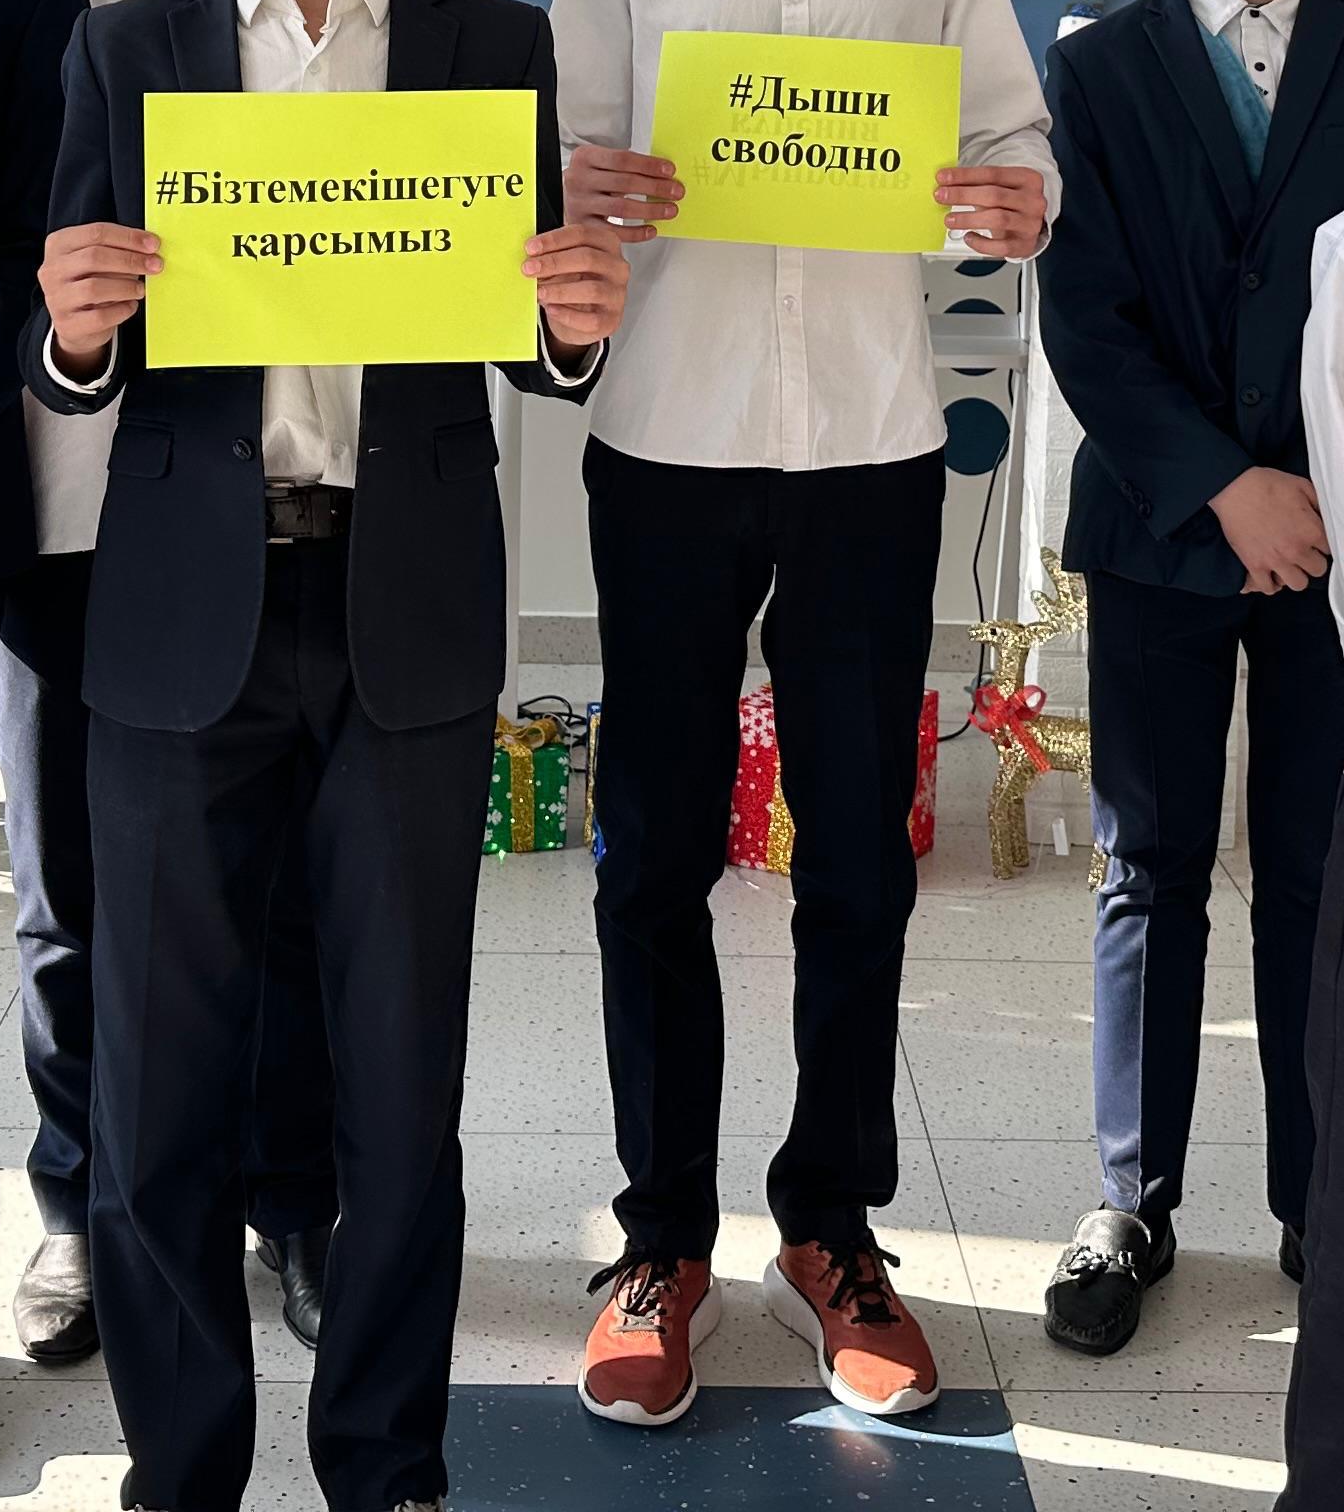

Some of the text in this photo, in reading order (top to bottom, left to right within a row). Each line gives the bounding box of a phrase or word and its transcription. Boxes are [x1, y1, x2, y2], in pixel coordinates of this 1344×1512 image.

[729, 73, 890, 119] #Дыши
[711, 133, 901, 174] свободно
[156, 168, 524, 208] #Бізтемекішегуге
[232, 228, 452, 266] қарсымыз
